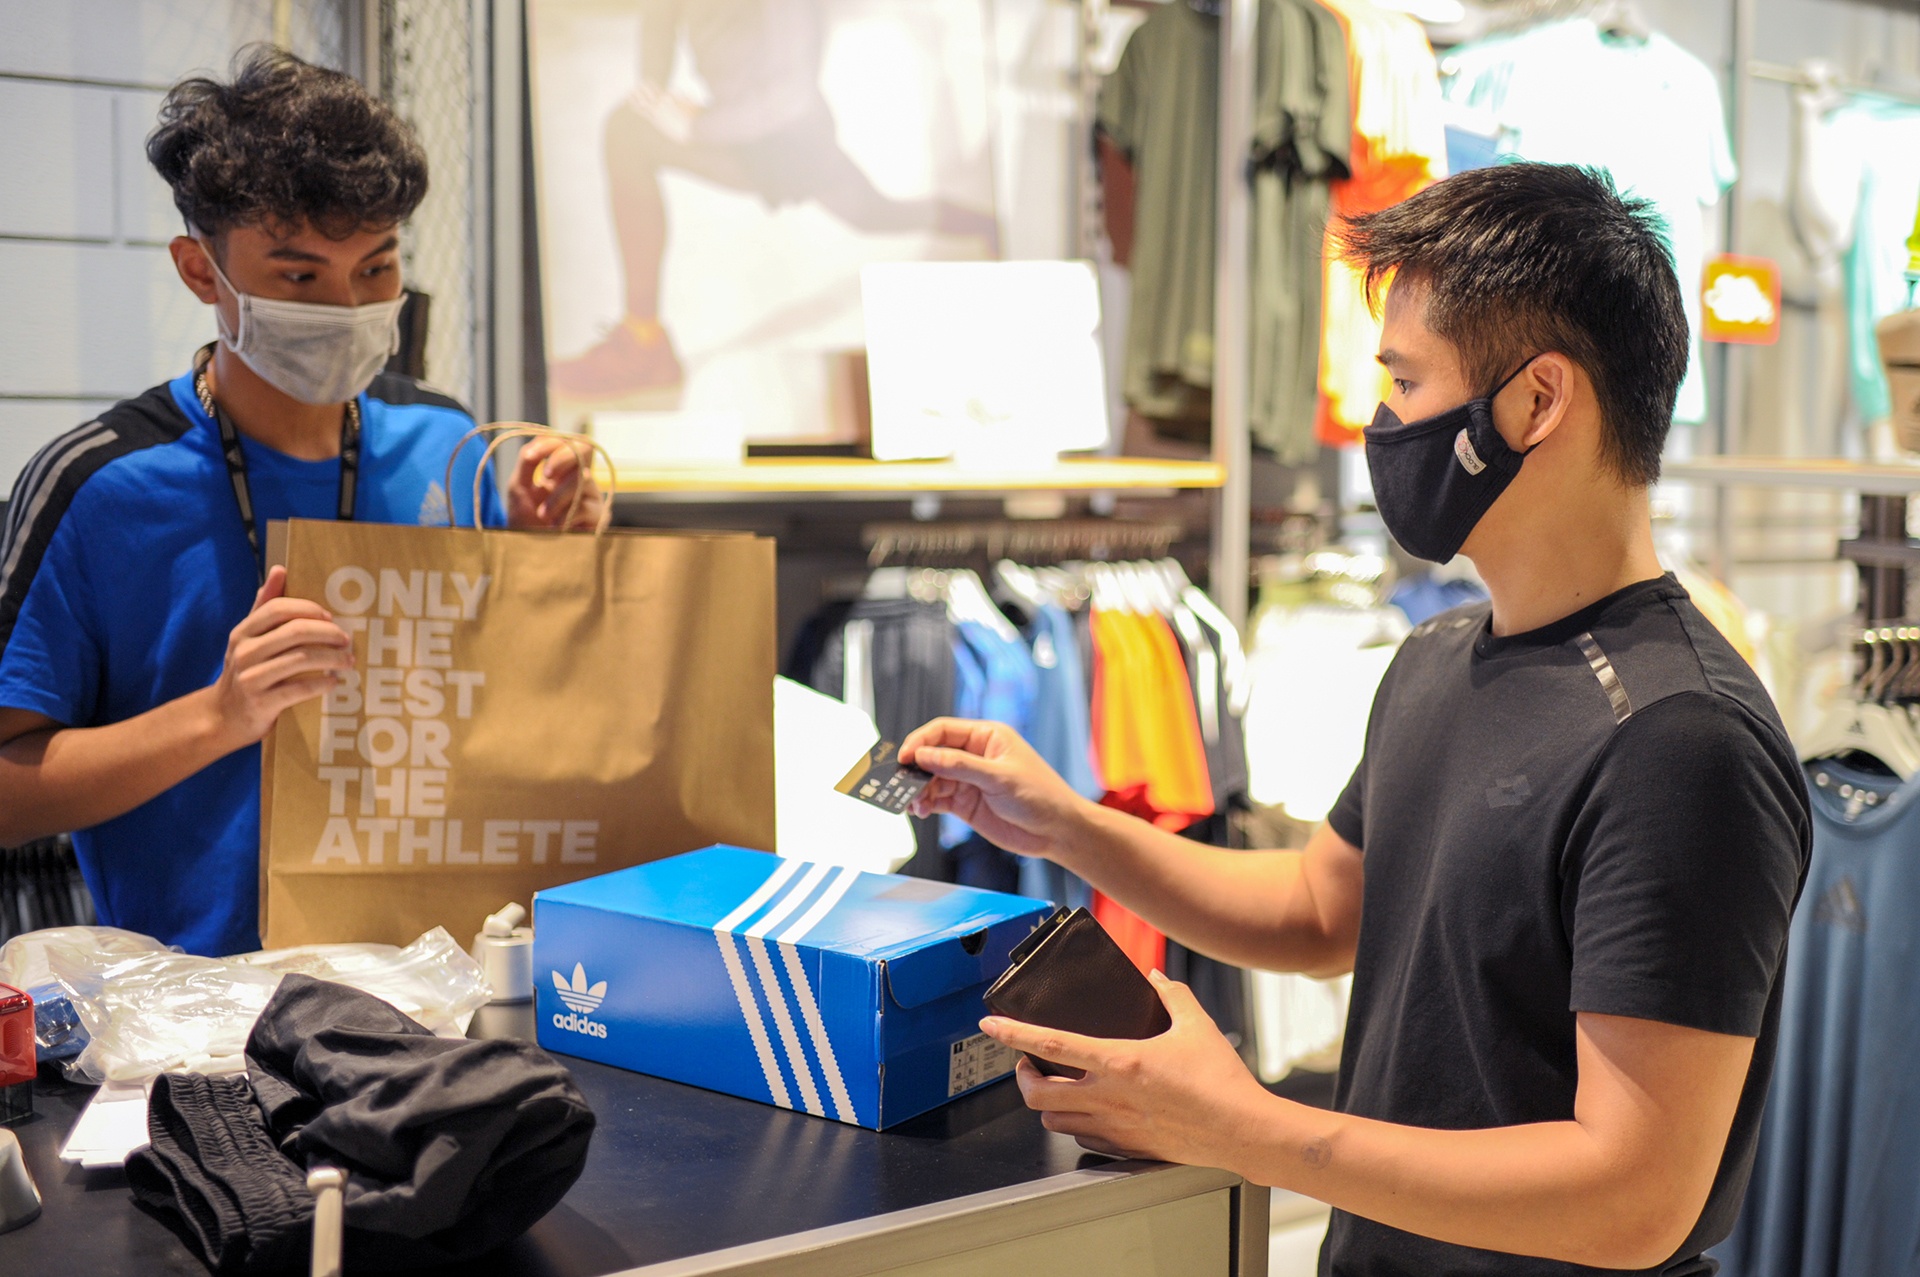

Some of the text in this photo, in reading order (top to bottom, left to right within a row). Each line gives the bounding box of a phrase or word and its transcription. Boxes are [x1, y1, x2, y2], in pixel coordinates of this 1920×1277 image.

[325, 565, 491, 621] ONLY
[331, 617, 454, 668] THE
[322, 667, 485, 719] BEST
[318, 716, 453, 768] FOR
[317, 766, 447, 817] THE
[311, 816, 599, 865] ATHLETE
[552, 1012, 608, 1039] adidas
